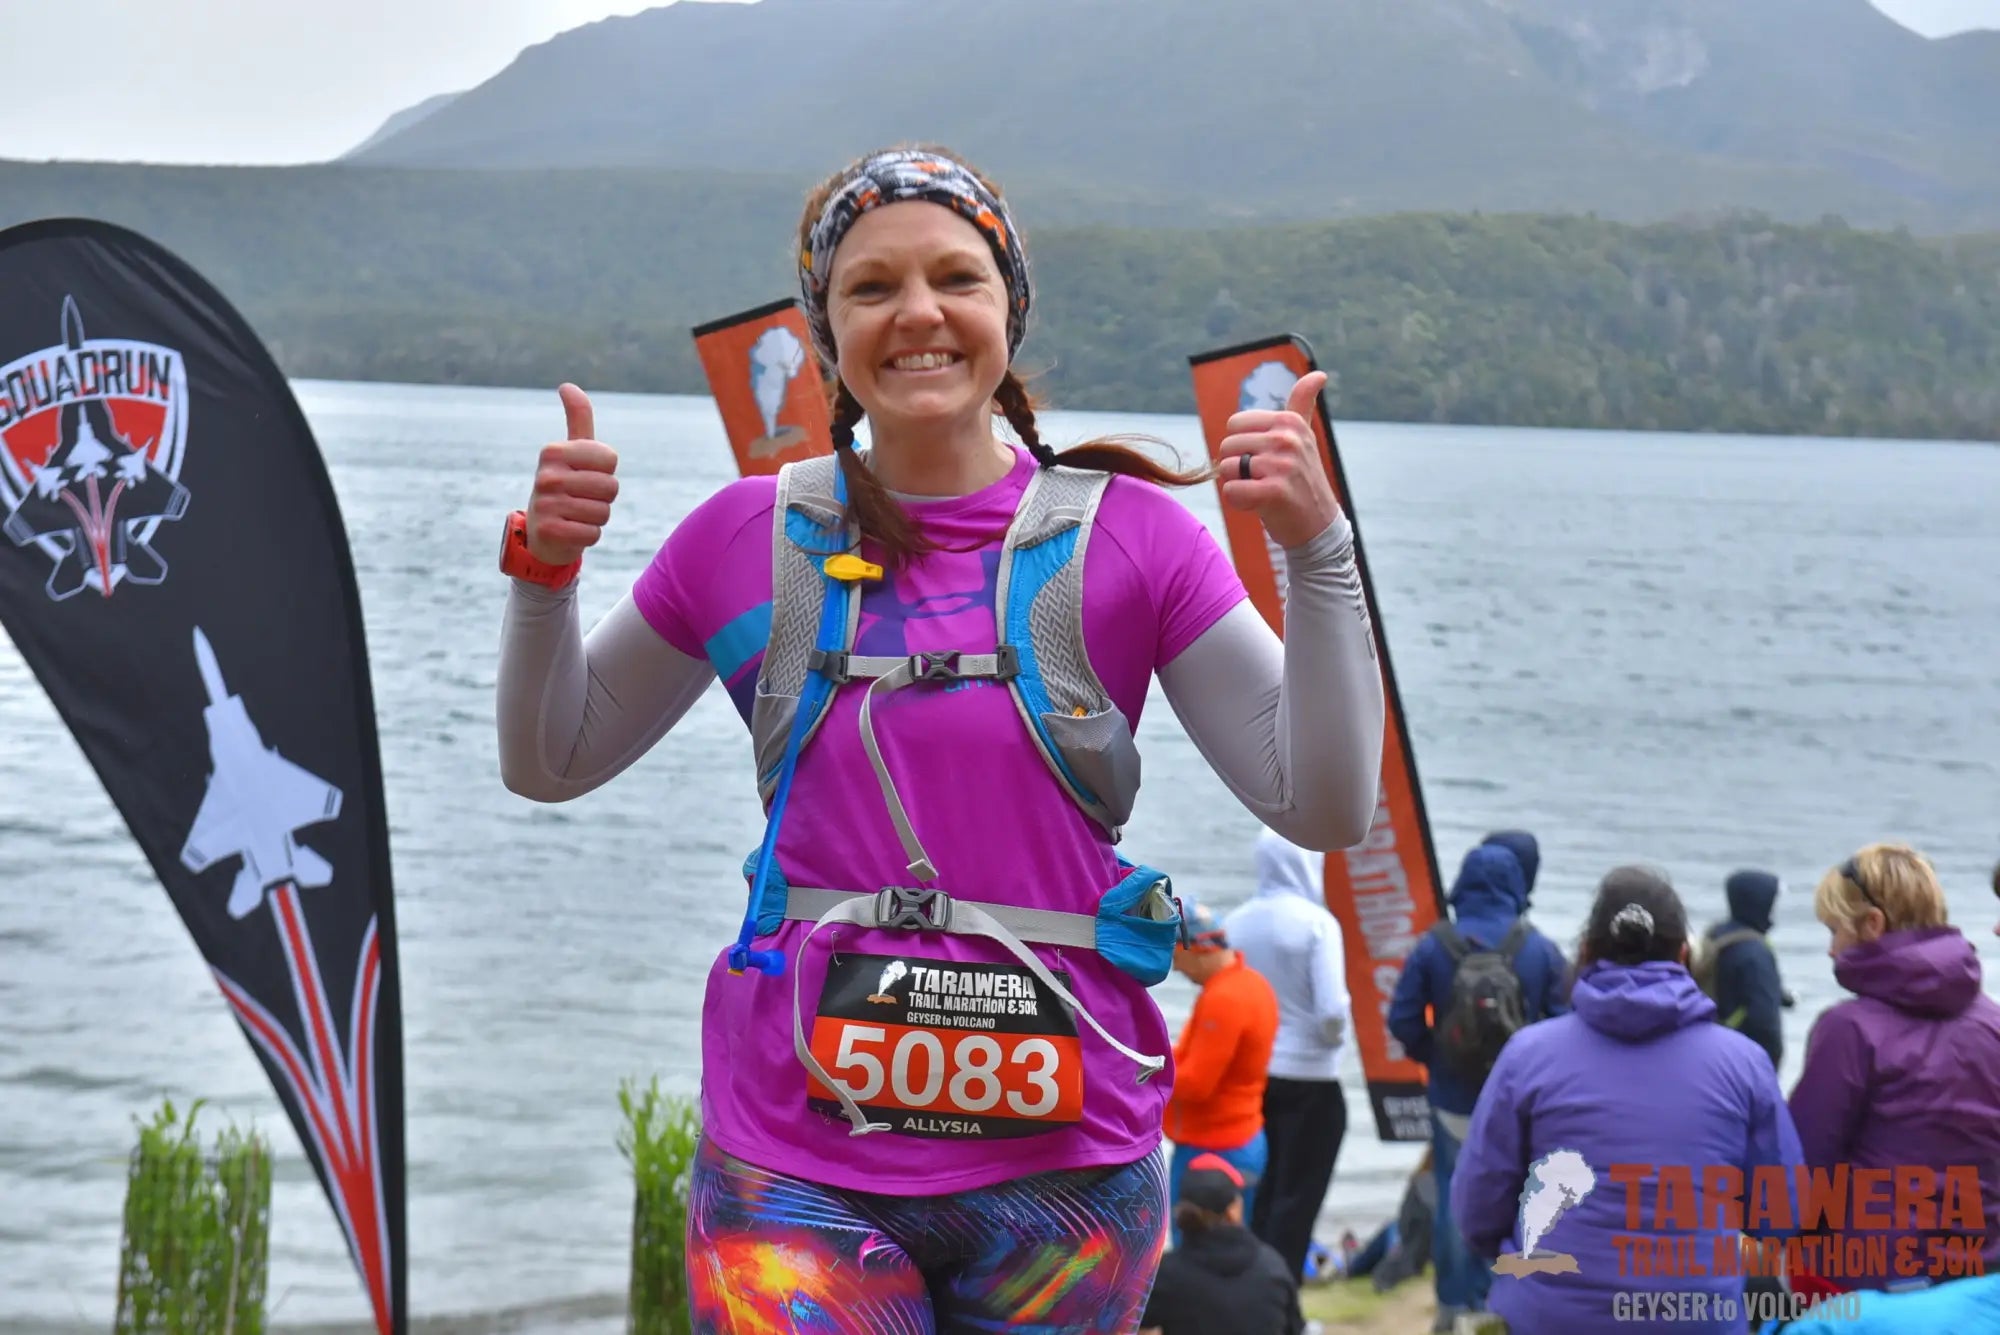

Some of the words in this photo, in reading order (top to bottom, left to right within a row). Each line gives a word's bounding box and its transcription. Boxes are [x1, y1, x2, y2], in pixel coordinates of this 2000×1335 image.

[1344, 785, 1418, 960] RATHON
[911, 966, 1037, 999] TARAWERA
[908, 991, 942, 1010] TRAIL
[943, 997, 1006, 1014] MARATHON
[906, 1011, 941, 1026] GEYSER
[942, 1015, 952, 1026] to
[953, 1015, 996, 1030] VOLCANO
[830, 1024, 1060, 1117] 5083
[902, 1117, 983, 1135] ALLYSIA
